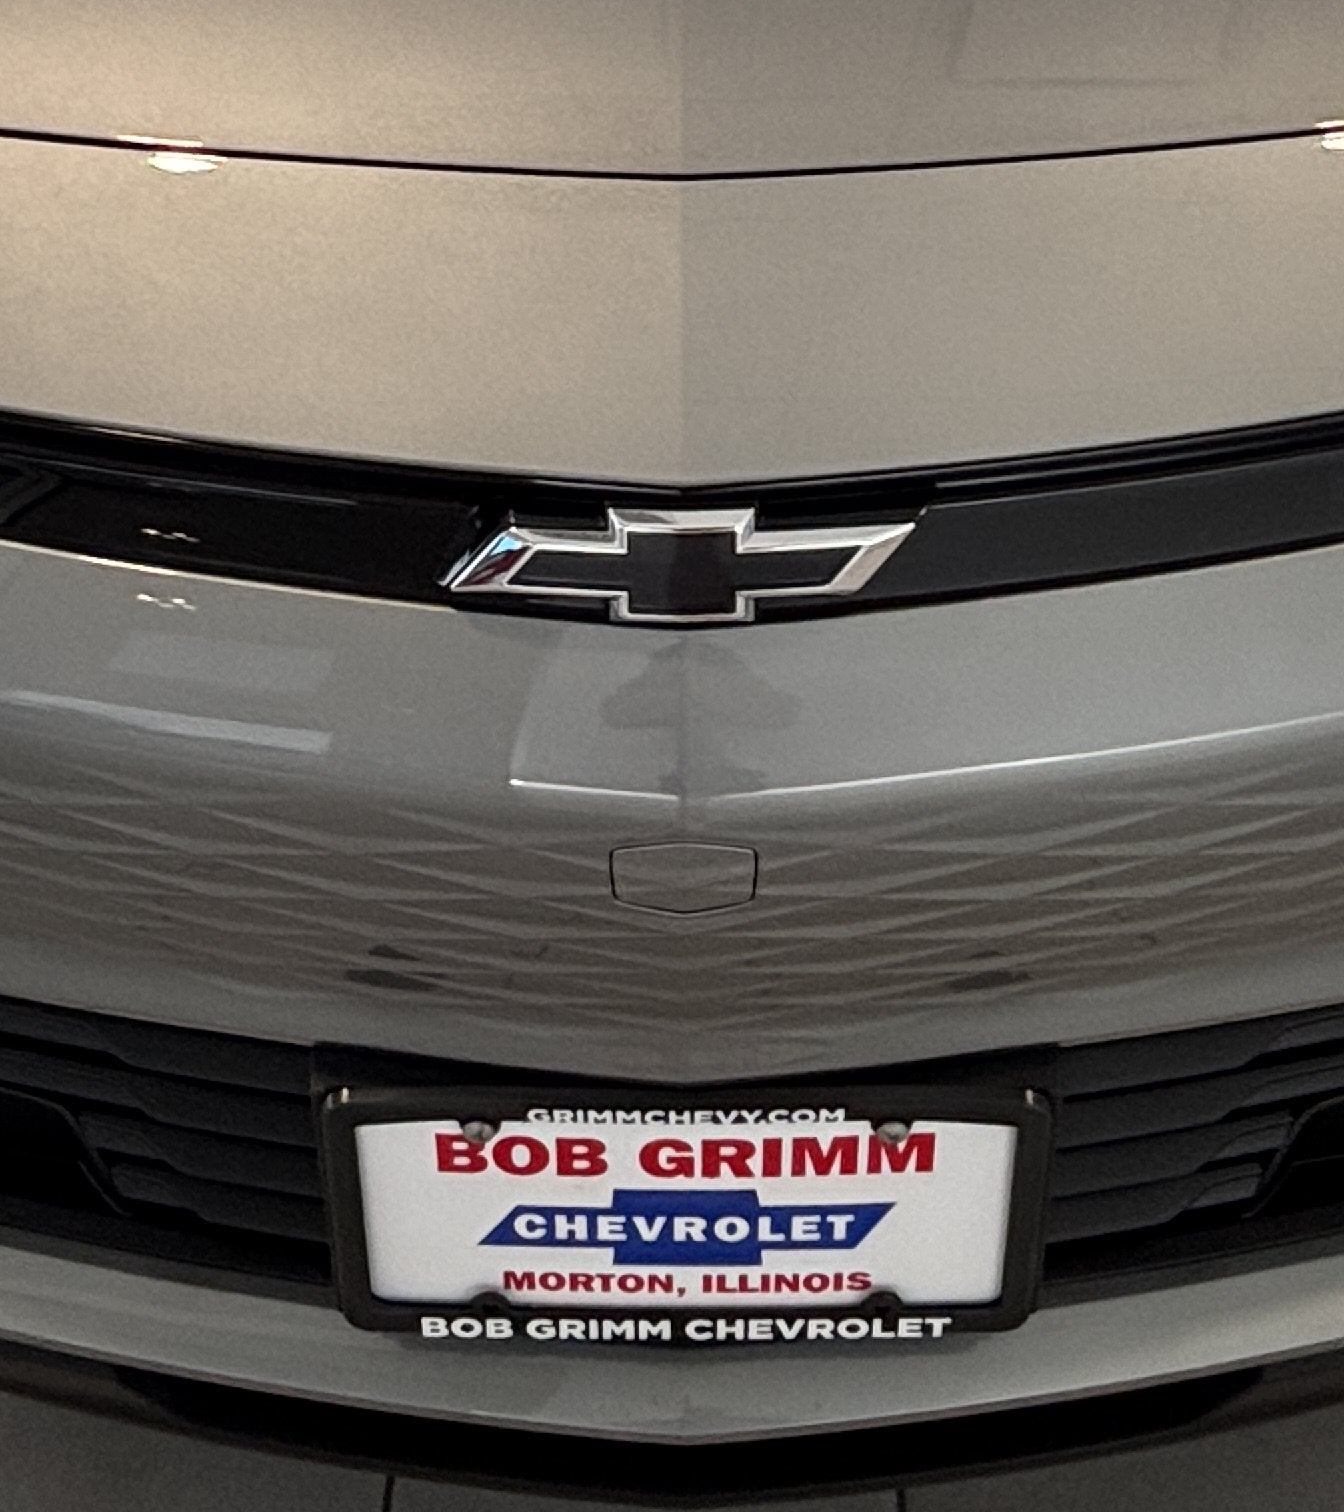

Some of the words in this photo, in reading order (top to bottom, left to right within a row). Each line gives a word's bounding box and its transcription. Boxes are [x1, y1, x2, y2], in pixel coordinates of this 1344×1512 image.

[526, 1107, 846, 1125] GRIMMCHEVY.COM
[434, 1132, 609, 1178] BOB
[638, 1132, 936, 1179] GRIMM
[512, 1212, 856, 1243] CHEVROLET
[502, 1270, 687, 1298] MORTON,
[702, 1271, 873, 1294] ILLINOIS
[420, 1316, 514, 1340] BOB
[525, 1318, 673, 1342] GRIMM
[684, 1316, 953, 1342] CHEVROLET
